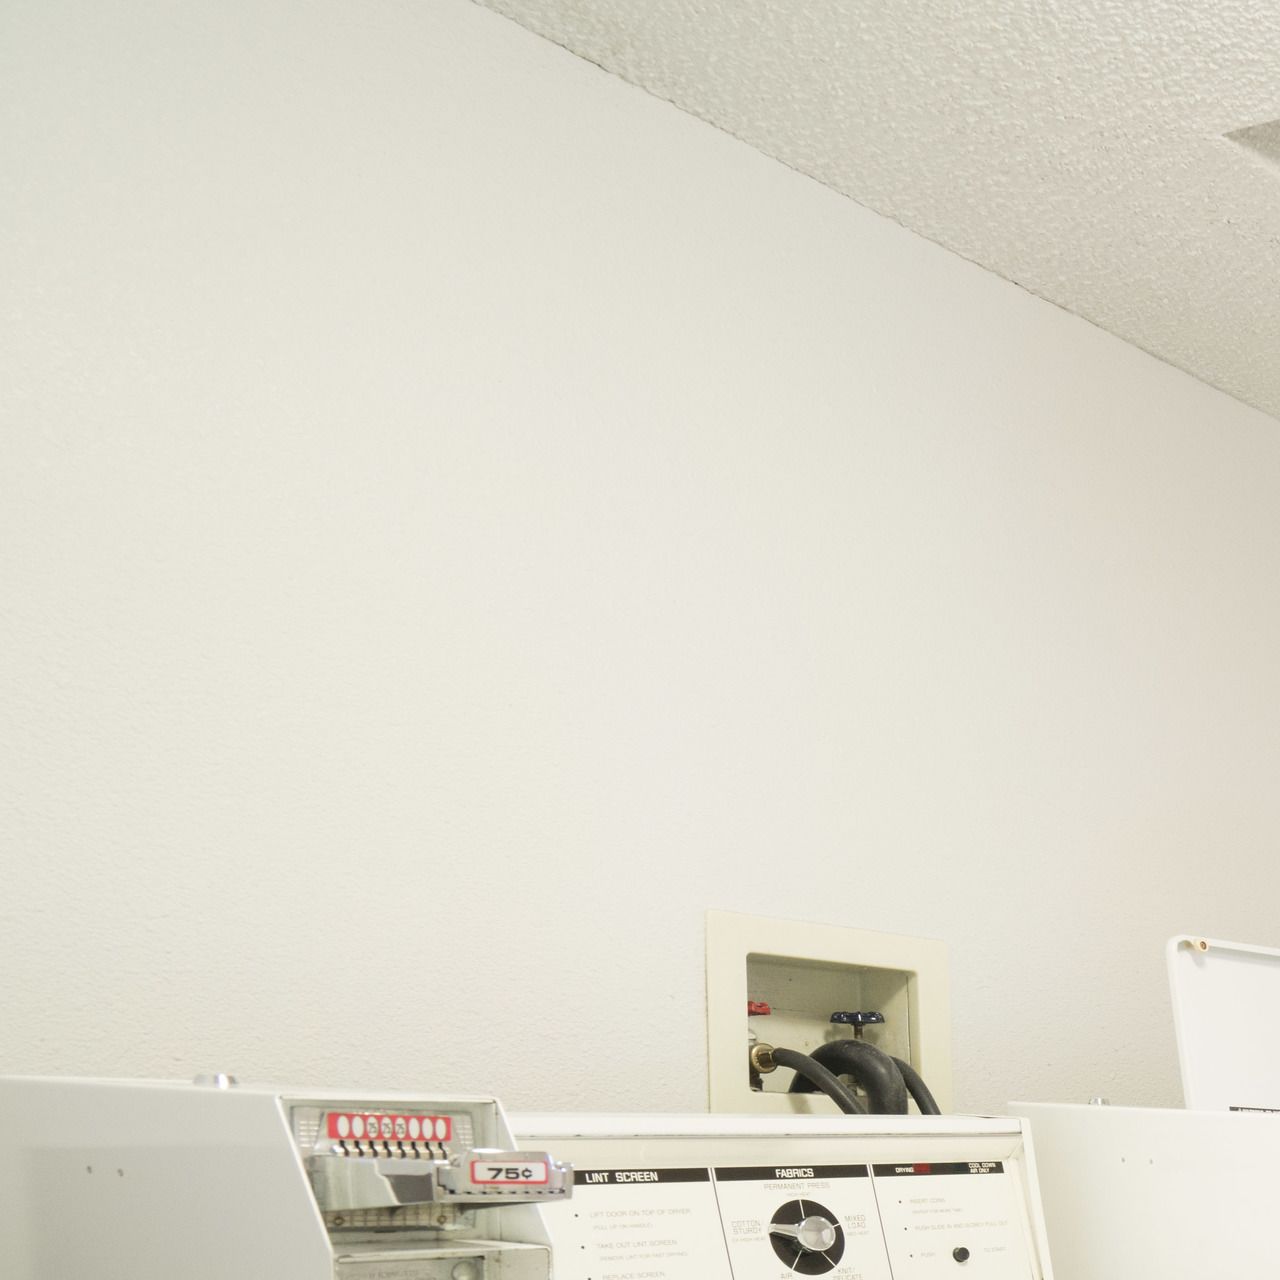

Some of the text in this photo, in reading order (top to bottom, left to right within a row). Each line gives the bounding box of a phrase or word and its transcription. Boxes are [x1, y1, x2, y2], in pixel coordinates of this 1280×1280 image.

[487, 1166, 533, 1181] 75¢
[585, 1171, 659, 1183] LINT SCREEN
[775, 1168, 814, 1178] FABRICS
[763, 1182, 806, 1190] PERMANENT
[832, 1273, 864, 1280] DELICATE
